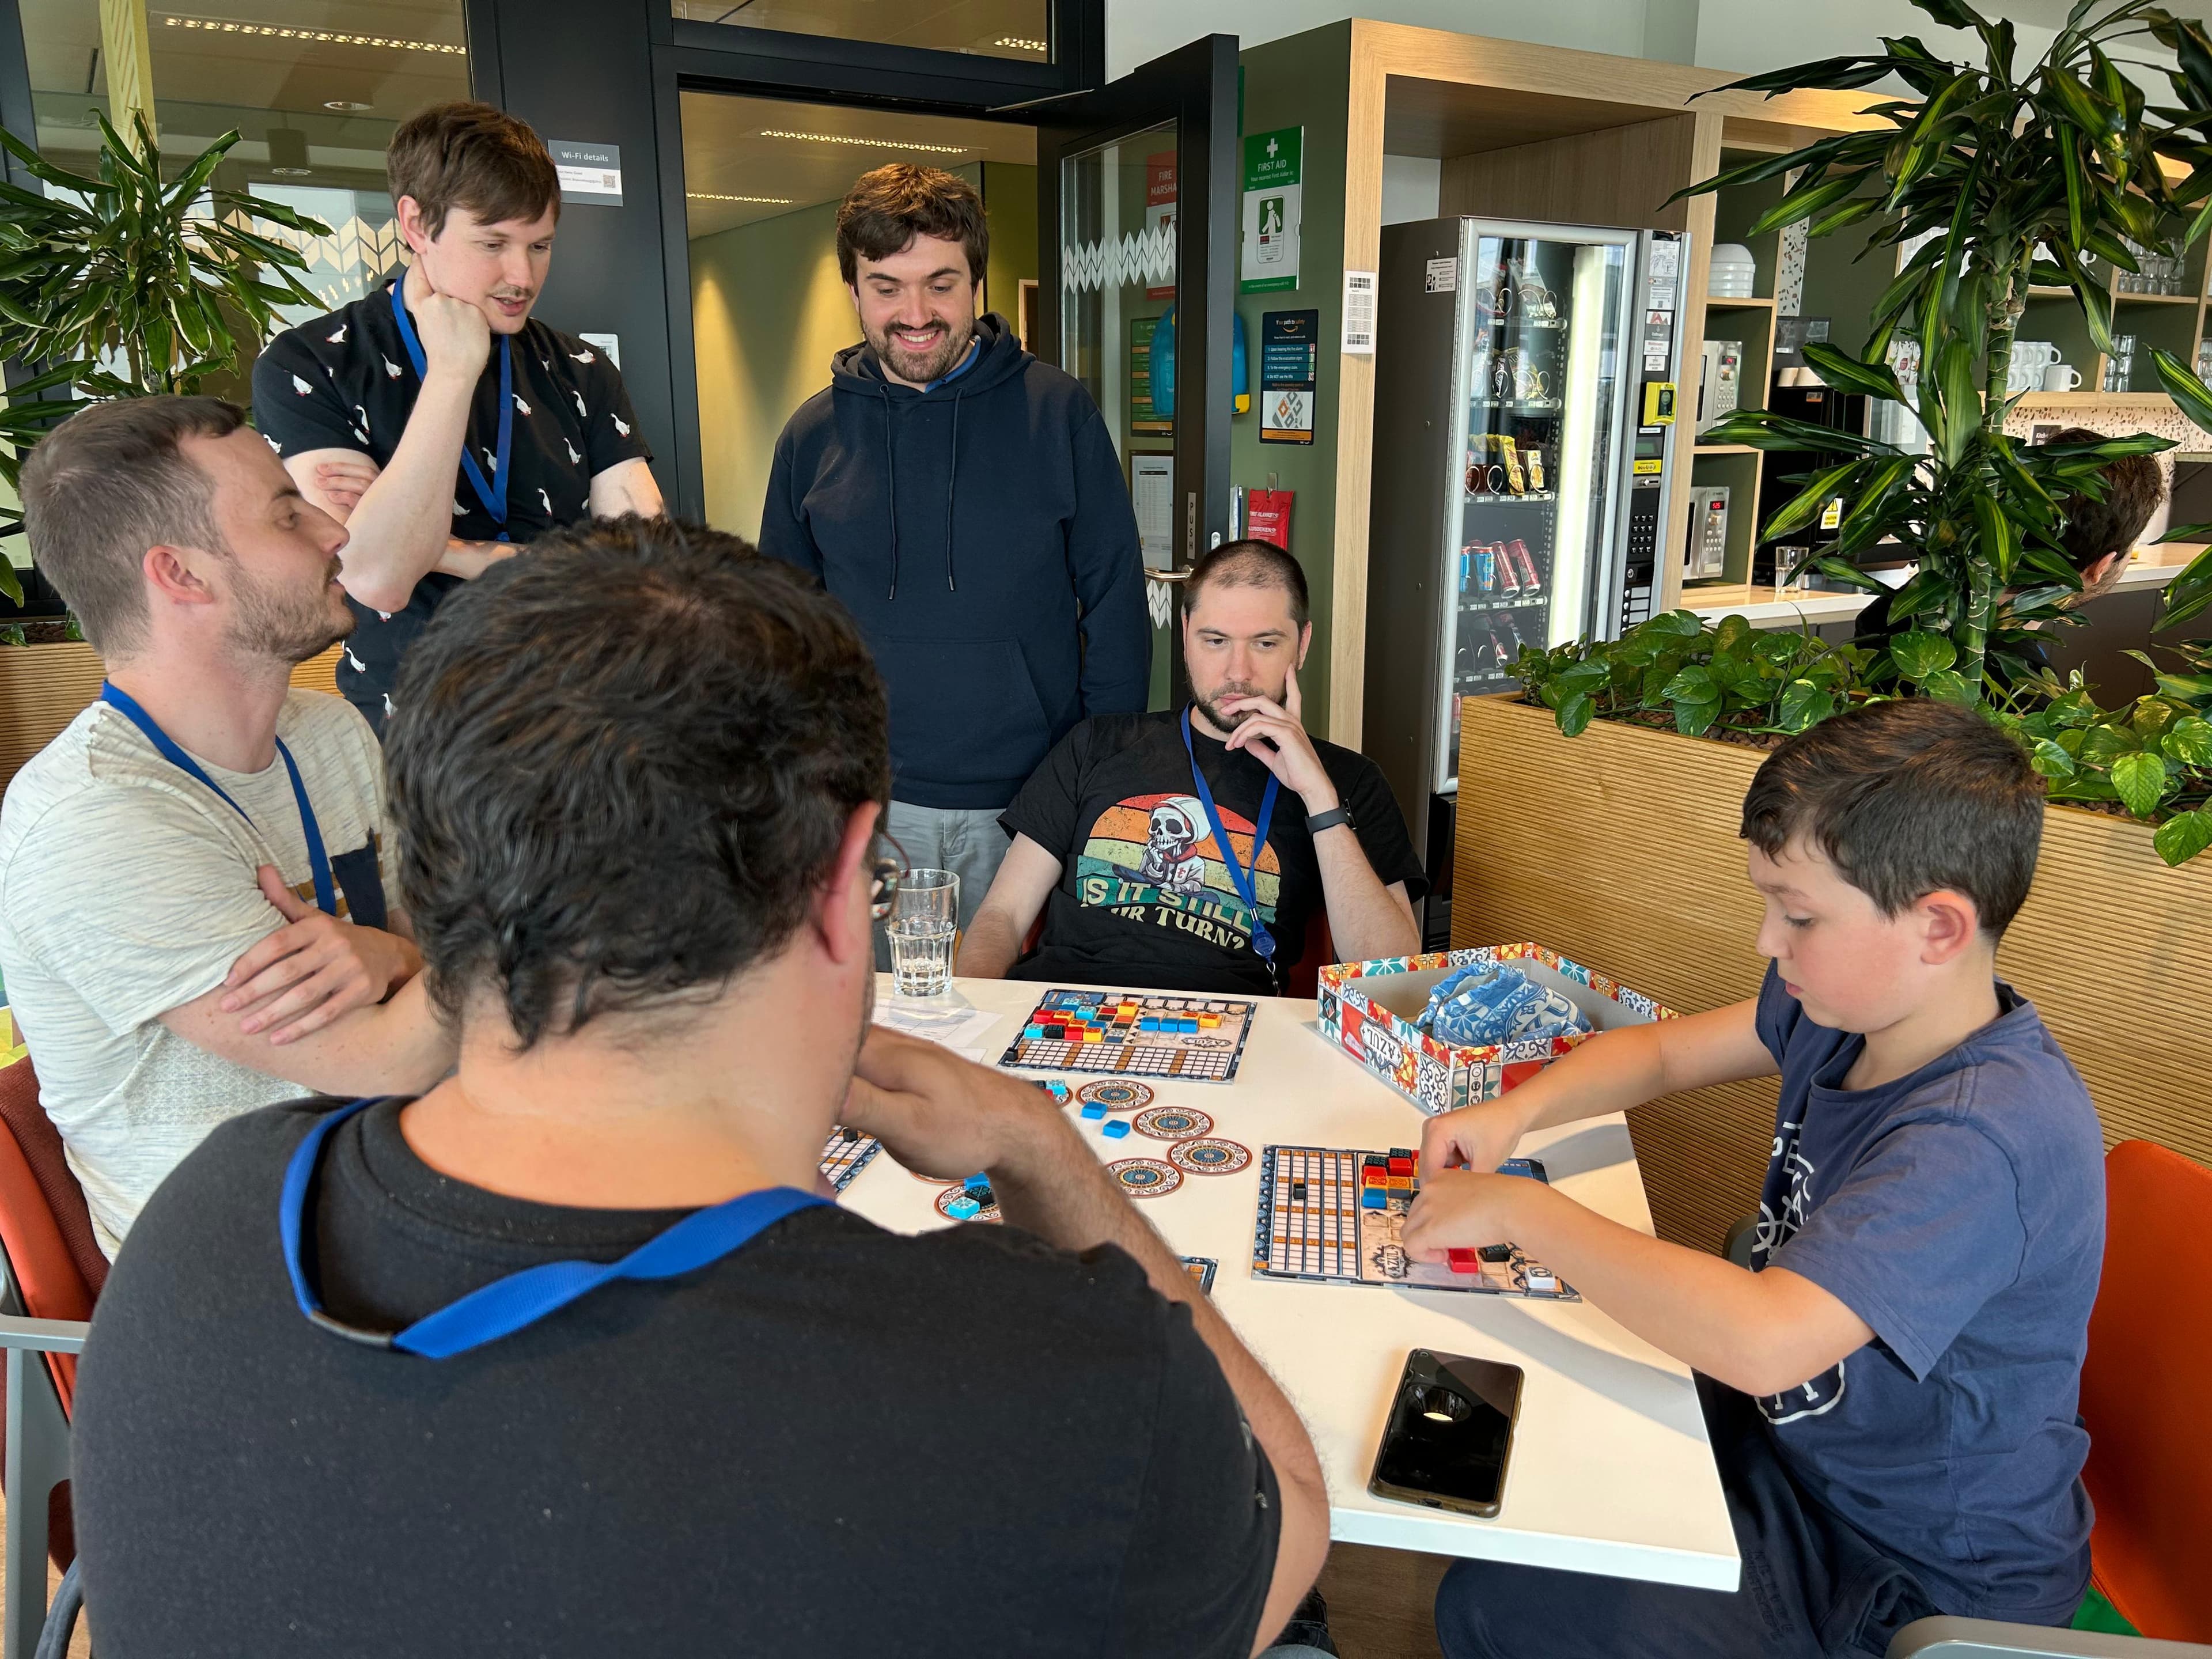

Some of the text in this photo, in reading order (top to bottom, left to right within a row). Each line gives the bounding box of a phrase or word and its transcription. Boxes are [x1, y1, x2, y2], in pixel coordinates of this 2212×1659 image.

[561, 151, 609, 162] Wi-Fi details
[1257, 159, 1287, 172] FIRST AID
[1158, 170, 1172, 181] FIRE
[1151, 183, 1177, 196] MARSHA
[1118, 882, 1152, 902] IT
[1154, 906, 1245, 949] TURN?
[1368, 1028, 1396, 1060] AZUL
[1387, 1251, 1400, 1272] AZUL
